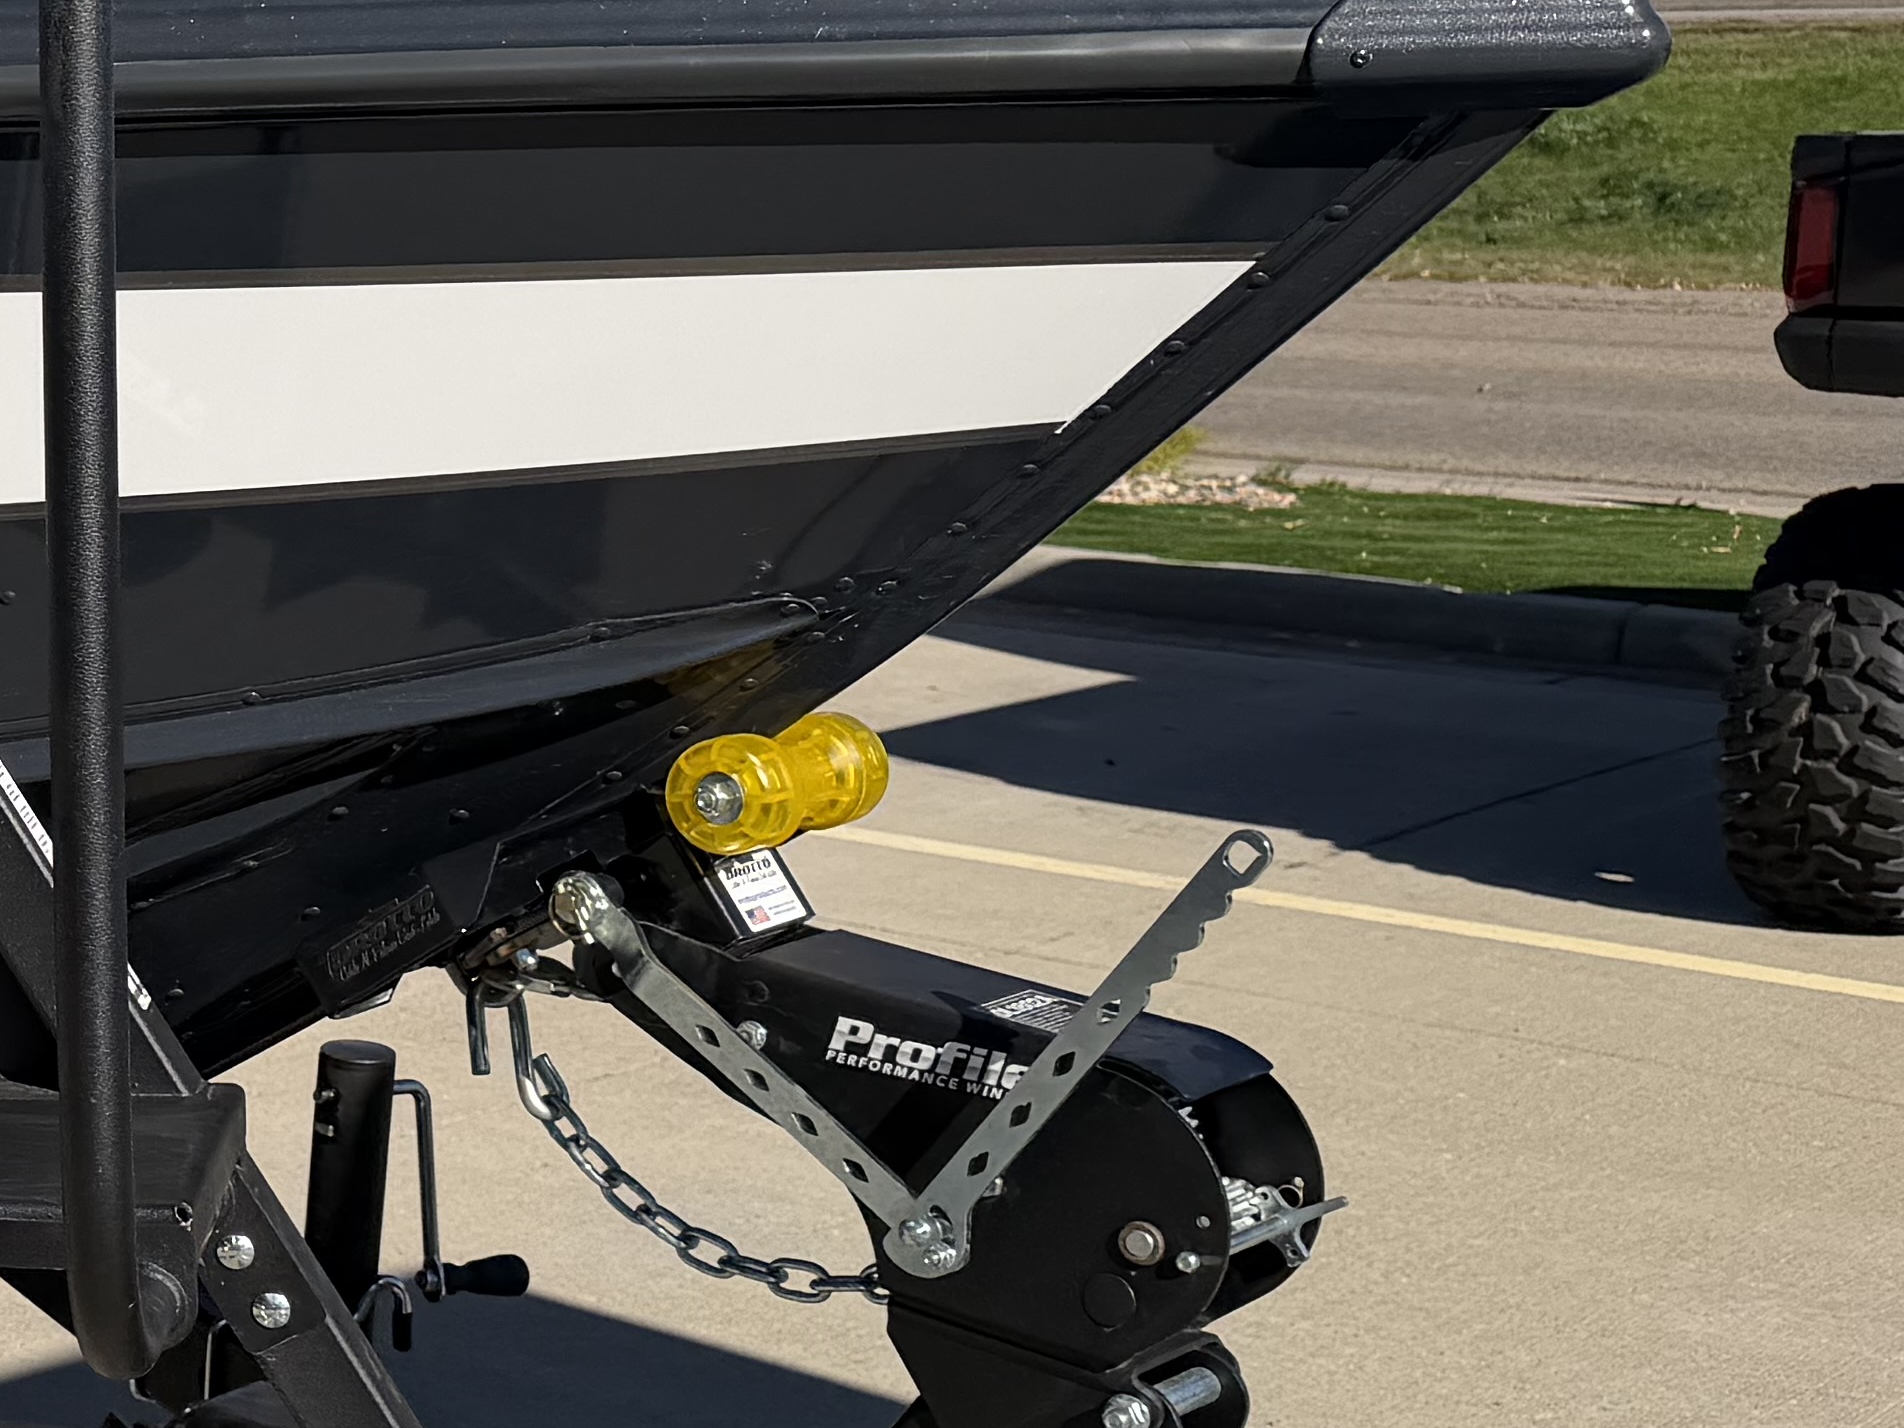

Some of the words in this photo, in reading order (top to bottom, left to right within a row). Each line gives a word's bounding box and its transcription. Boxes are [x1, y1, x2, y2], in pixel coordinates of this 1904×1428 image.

[825, 1049, 960, 1091] PERFORMANCE
[965, 1081, 1009, 1101] WIN
[827, 1015, 1030, 1090] Profile
